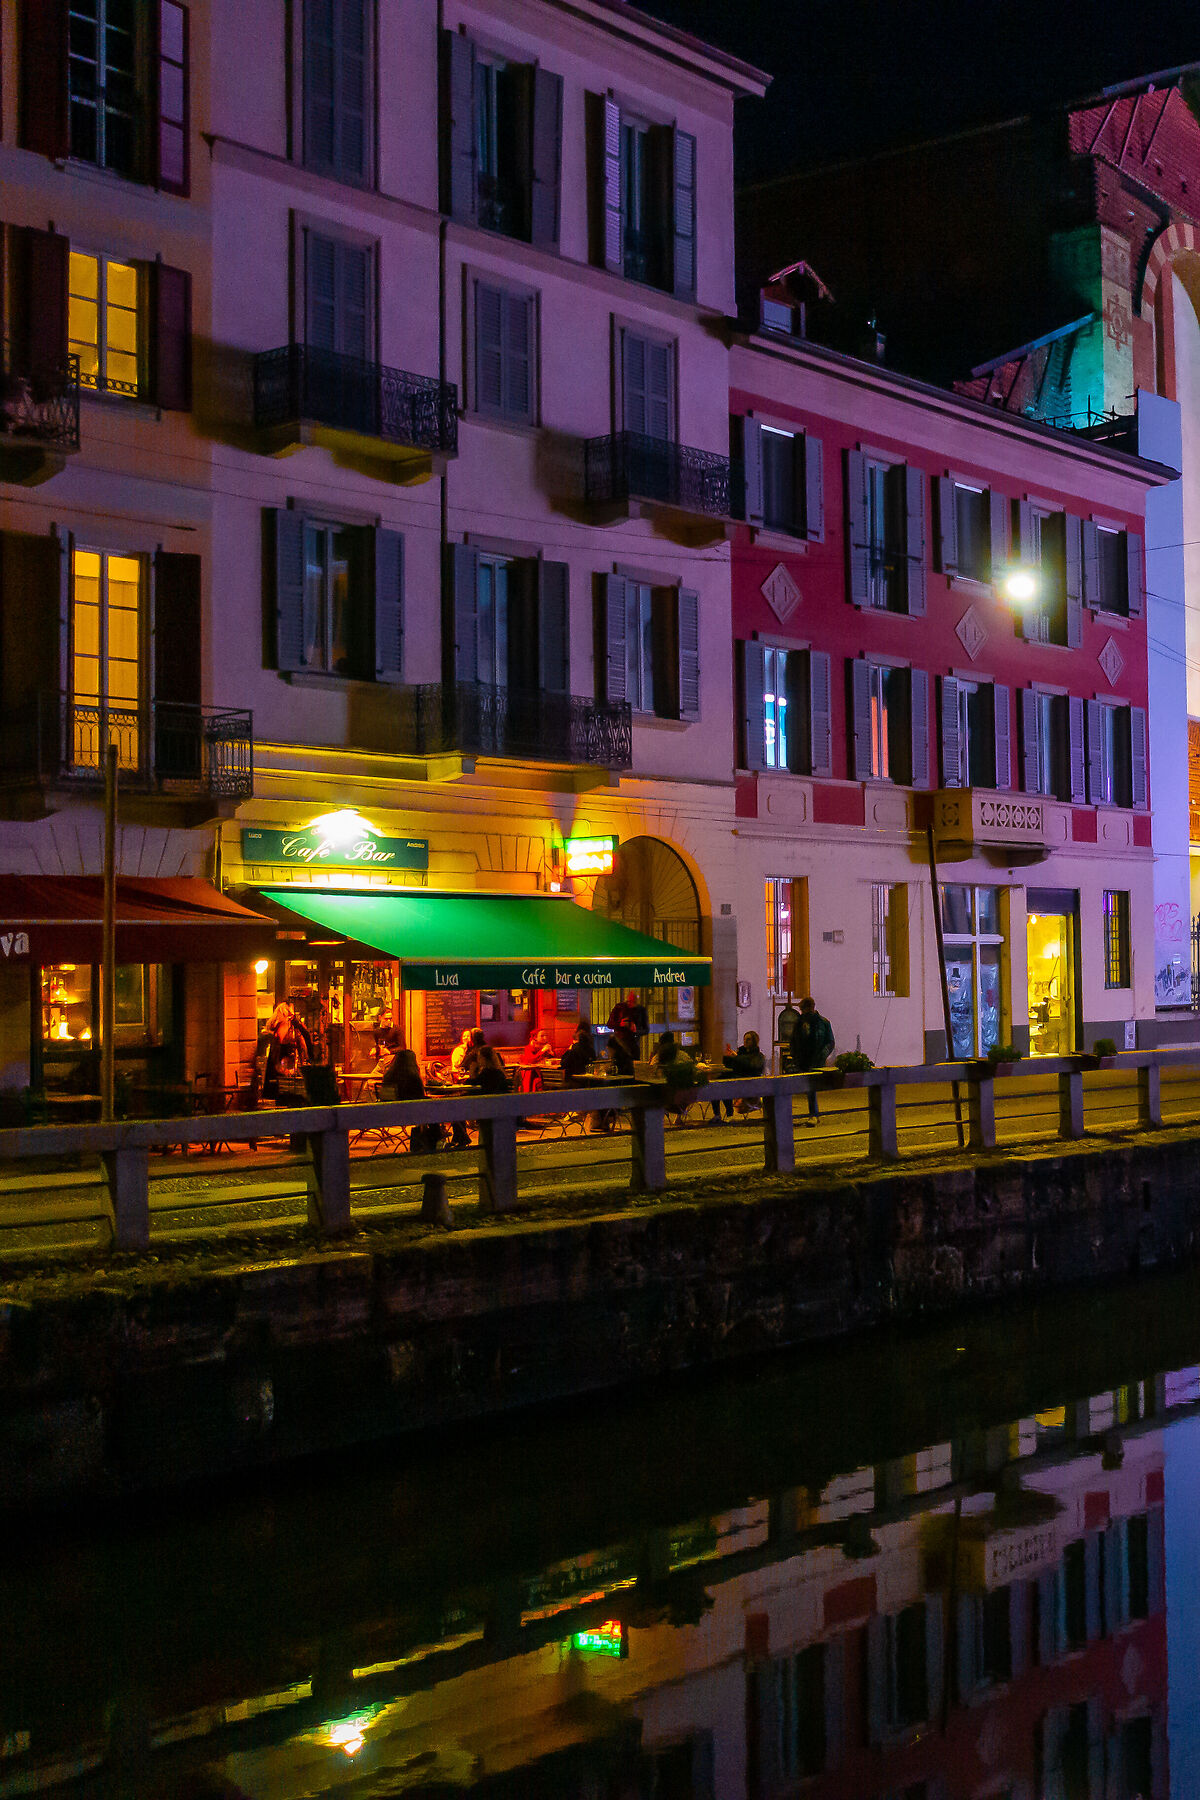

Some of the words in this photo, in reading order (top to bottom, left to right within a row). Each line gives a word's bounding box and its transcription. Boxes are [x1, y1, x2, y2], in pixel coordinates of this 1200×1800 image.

[344, 840, 396, 861] Bar
[435, 969, 459, 986] Luca
[522, 968, 546, 985] Café
[555, 969, 573, 985] bar
[575, 973, 581, 984] e
[583, 970, 612, 984] cucina
[653, 967, 686, 983] Andrea
